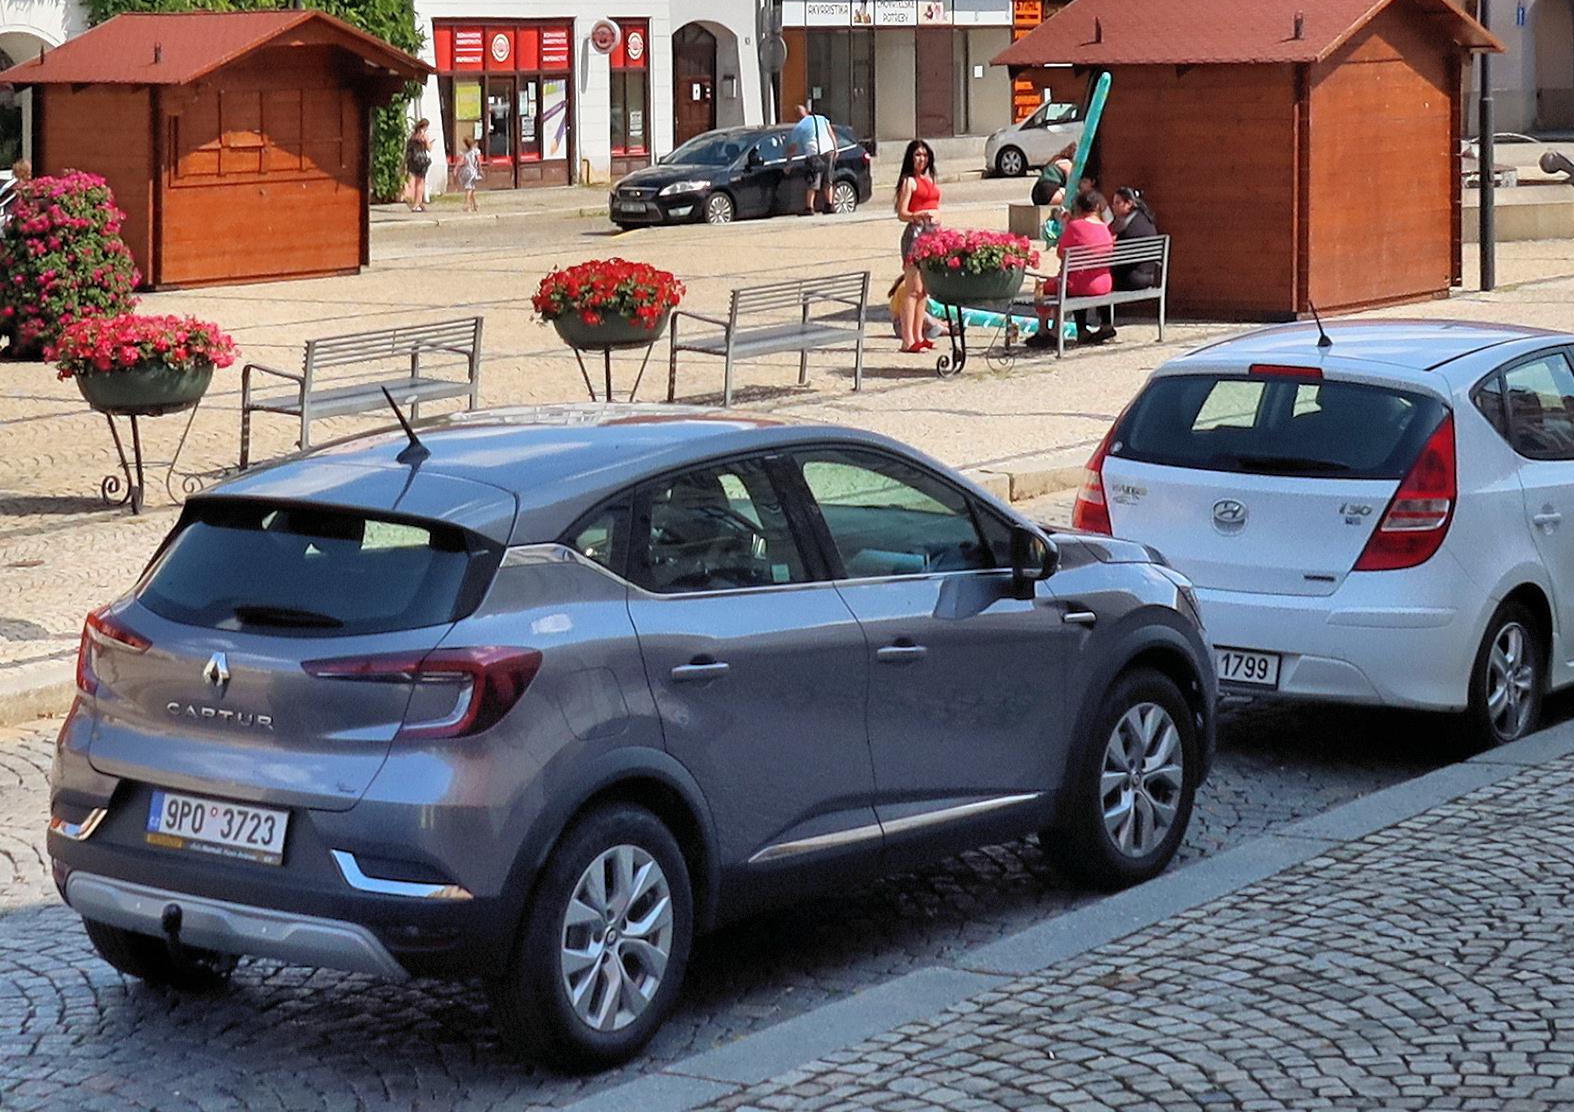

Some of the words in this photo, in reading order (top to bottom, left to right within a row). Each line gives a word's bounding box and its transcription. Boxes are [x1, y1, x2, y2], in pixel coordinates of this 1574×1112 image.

[1221, 652, 1268, 680] 1799
[166, 701, 275, 731] CAPTUR
[220, 808, 276, 846] 3723
